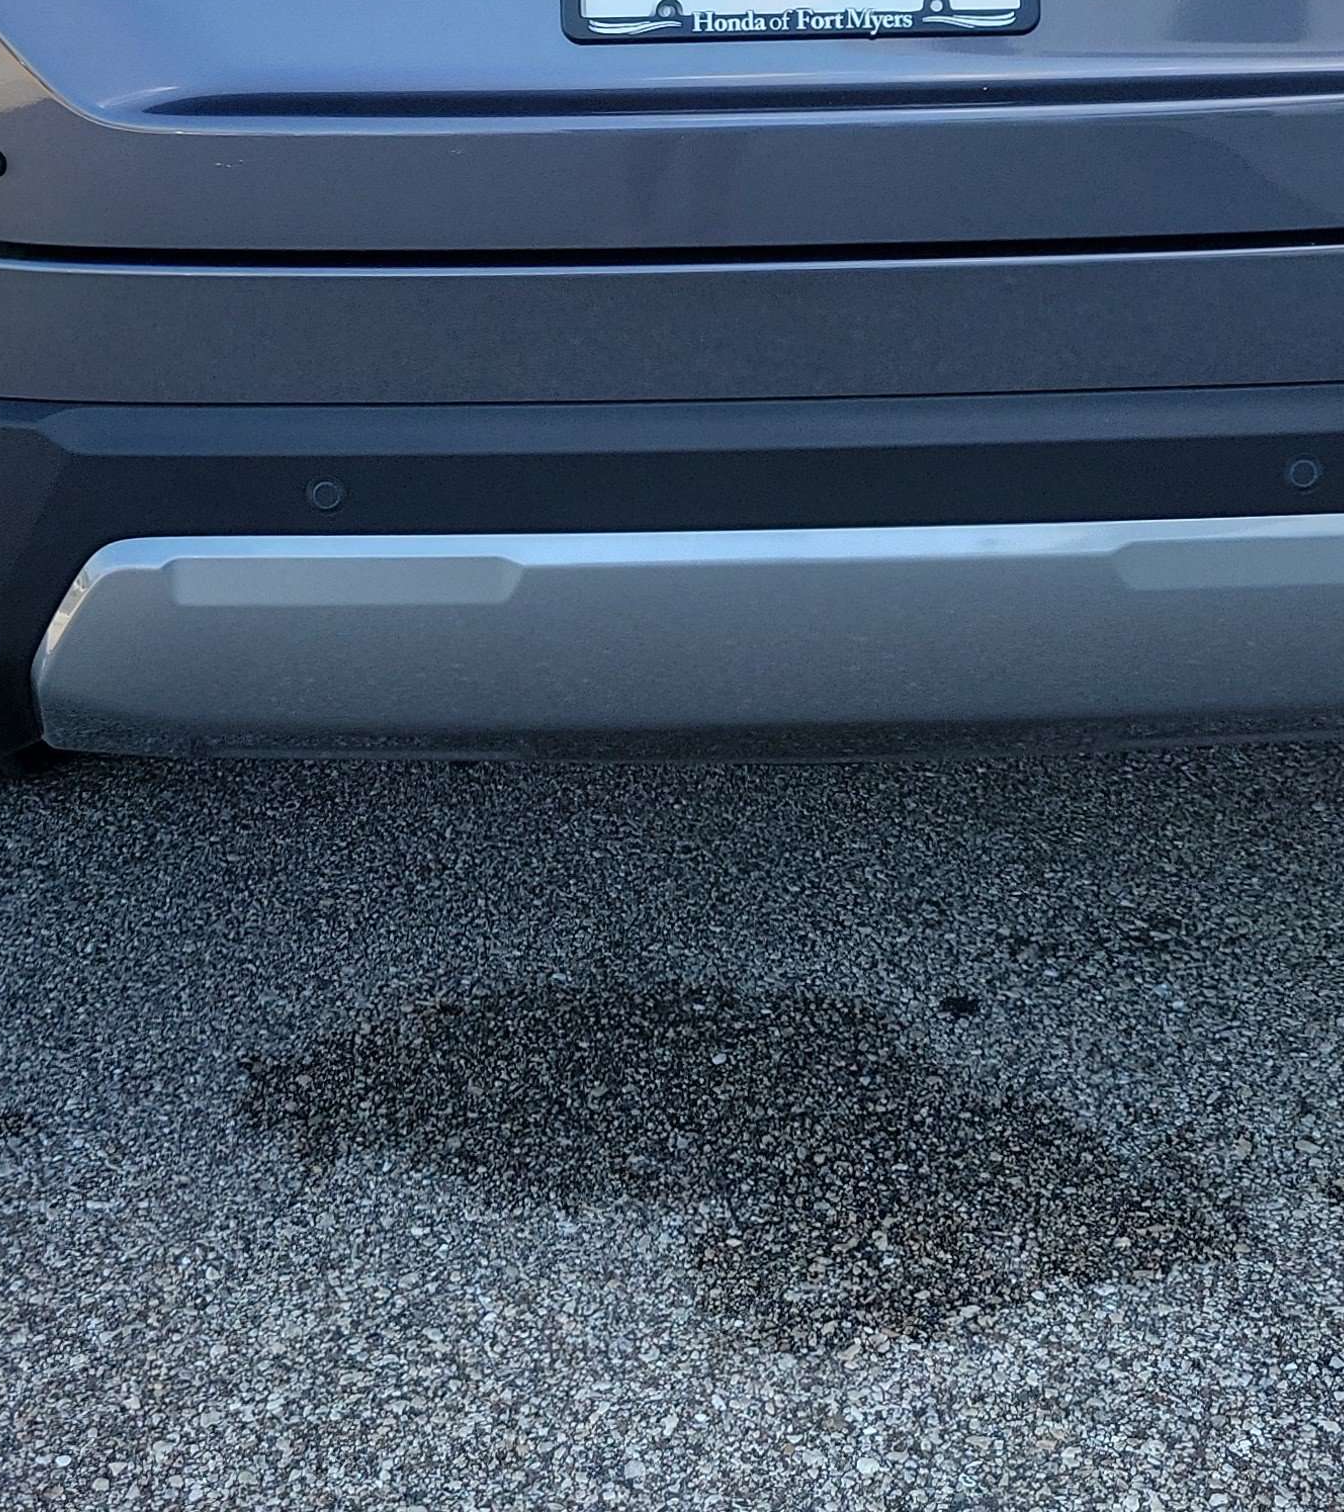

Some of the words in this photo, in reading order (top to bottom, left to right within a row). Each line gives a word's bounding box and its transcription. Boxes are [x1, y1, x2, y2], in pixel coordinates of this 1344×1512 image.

[692, 9, 767, 32] Honda
[769, 9, 793, 30] of
[795, 8, 844, 30] Fort
[845, 8, 913, 35] Myers
